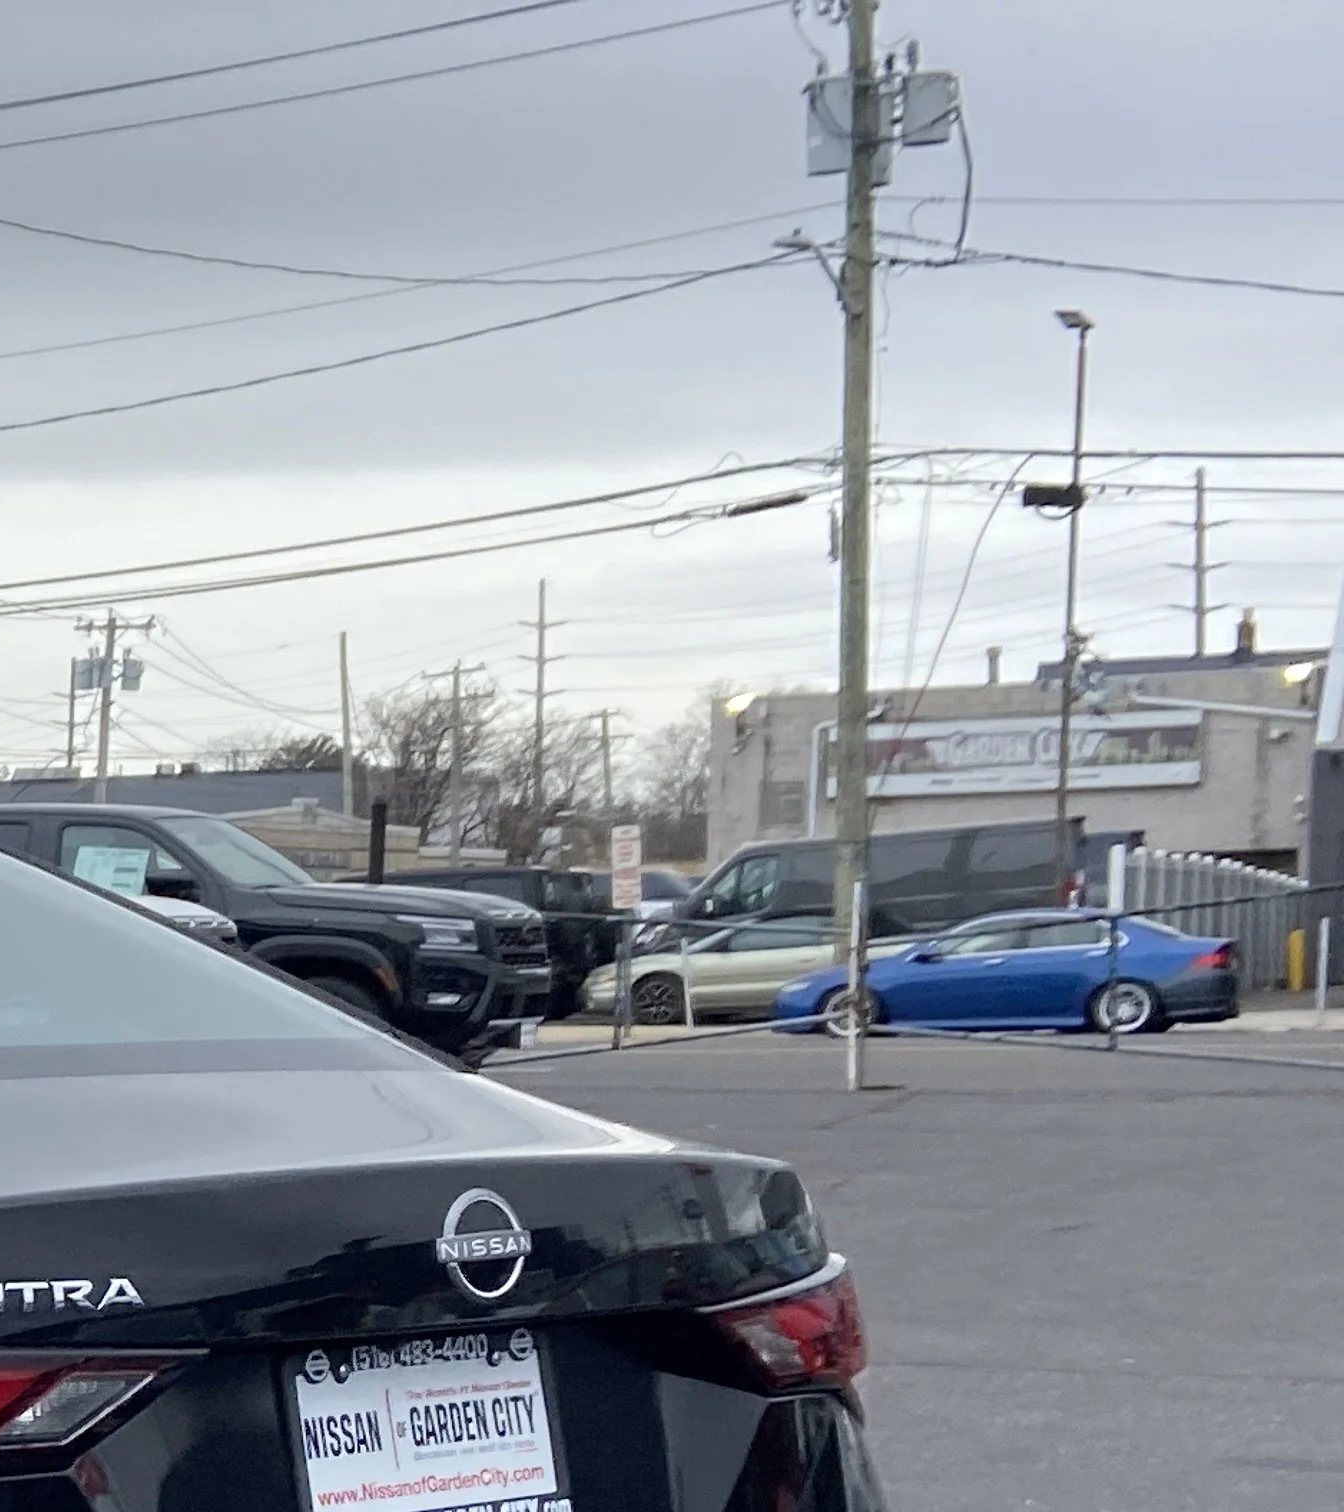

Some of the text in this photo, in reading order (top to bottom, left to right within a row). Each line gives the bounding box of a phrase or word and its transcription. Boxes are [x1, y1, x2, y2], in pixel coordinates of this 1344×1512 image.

[440, 1236, 531, 1259] NISSAN
[304, 1410, 383, 1460] NISSAN
[410, 1399, 490, 1446] GARDEN
[491, 1393, 536, 1437] CITY
[317, 1465, 545, 1507] www.NissanofGardenCity.com
